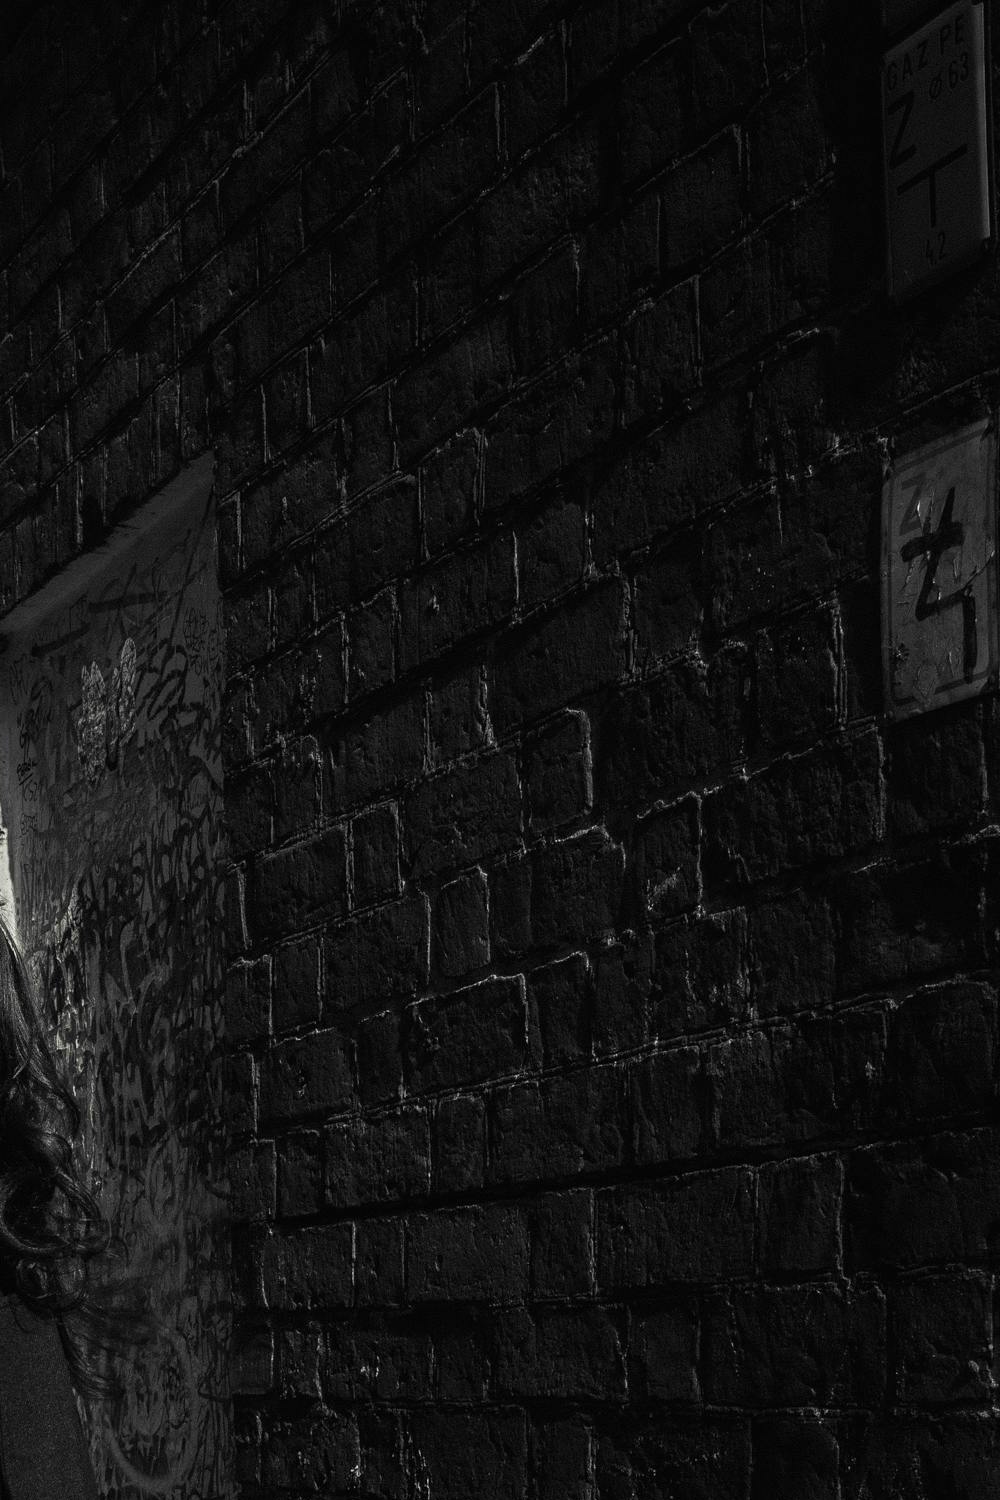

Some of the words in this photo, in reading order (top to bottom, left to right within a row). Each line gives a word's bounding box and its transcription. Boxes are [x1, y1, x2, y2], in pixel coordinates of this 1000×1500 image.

[887, 39, 929, 91] GAZ
[939, 13, 966, 56] PE
[887, 90, 917, 169] Z
